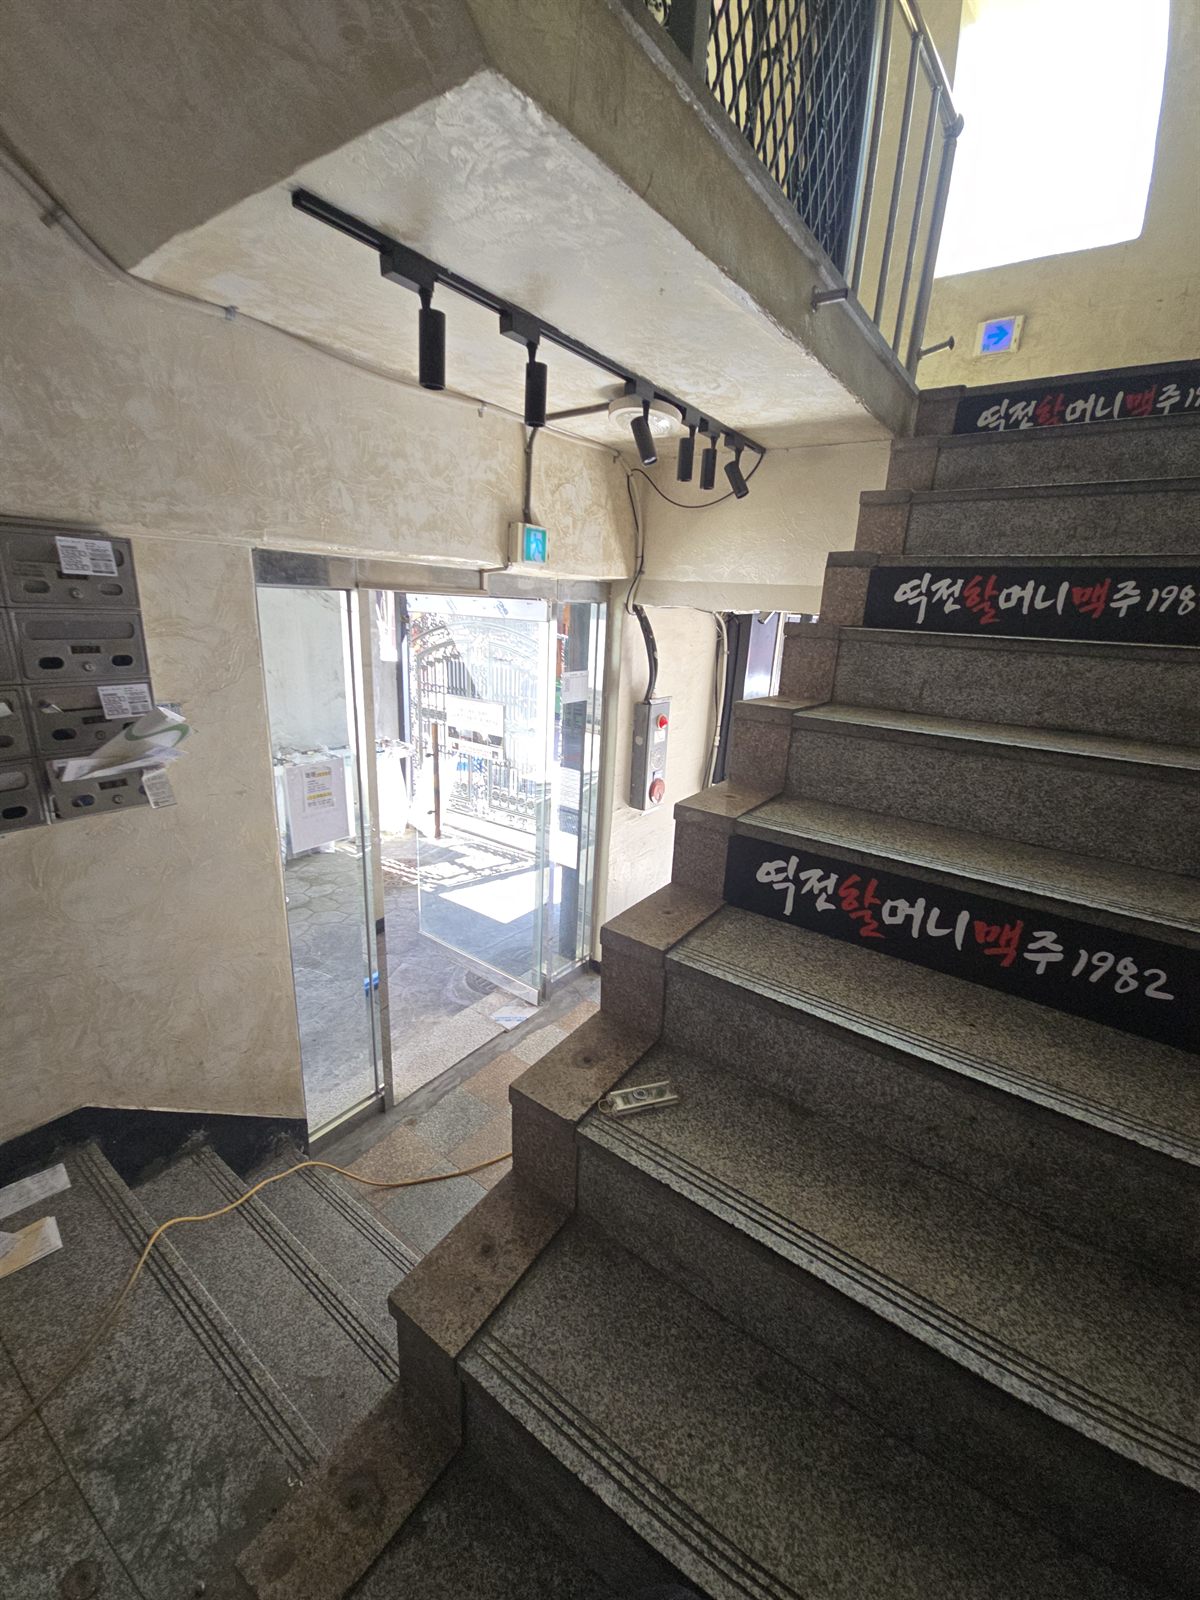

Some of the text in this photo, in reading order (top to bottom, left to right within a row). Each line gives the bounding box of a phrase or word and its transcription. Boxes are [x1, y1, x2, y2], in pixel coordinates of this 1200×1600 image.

[977, 384, 1181, 431] 역전할머니맥주
[893, 572, 1200, 625] 역전할머니맥주 198
[756, 856, 1175, 1001] 역전할머니맥주 1982
